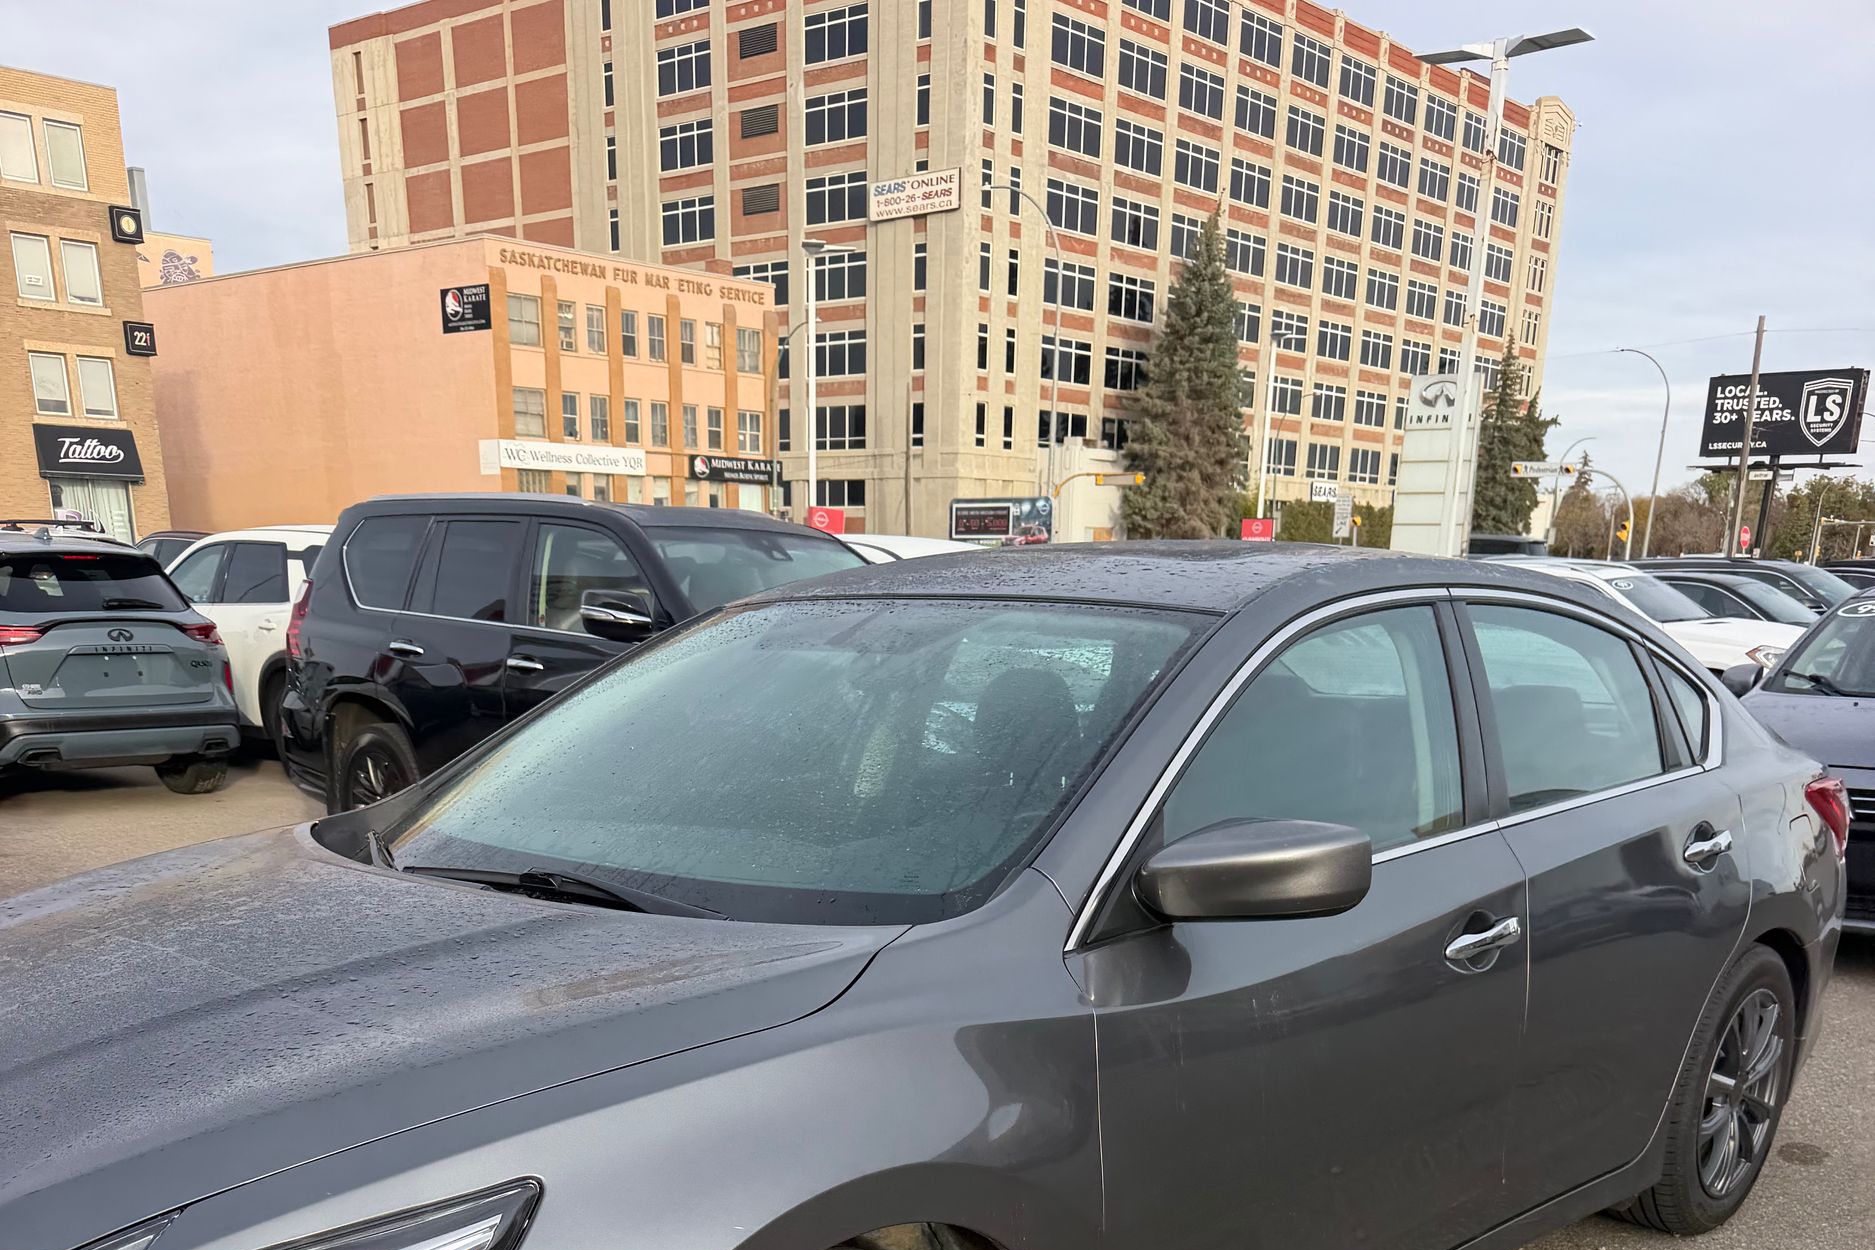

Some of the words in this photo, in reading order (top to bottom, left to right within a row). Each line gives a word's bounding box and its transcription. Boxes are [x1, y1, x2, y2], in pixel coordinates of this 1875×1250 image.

[873, 181, 907, 197] SEARS
[911, 174, 956, 190] ONLINE
[877, 188, 953, 208] 1-800-26-SEARS
[876, 200, 953, 217] www.sears.ca
[499, 248, 607, 280] SASKATCHEWAN
[613, 267, 638, 284] FUR
[719, 286, 765, 305] SERVICE
[1715, 396, 1783, 411] TRUSTED.
[1806, 394, 1843, 422] LS
[1409, 413, 1472, 425] INFINI
[1712, 412, 1738, 424] 30+
[57, 437, 124, 463] Tattoo
[1708, 441, 1767, 450] LSSECURY.CA
[529, 450, 573, 464] Wellness
[575, 453, 620, 467] Collective
[622, 456, 643, 470] YQR
